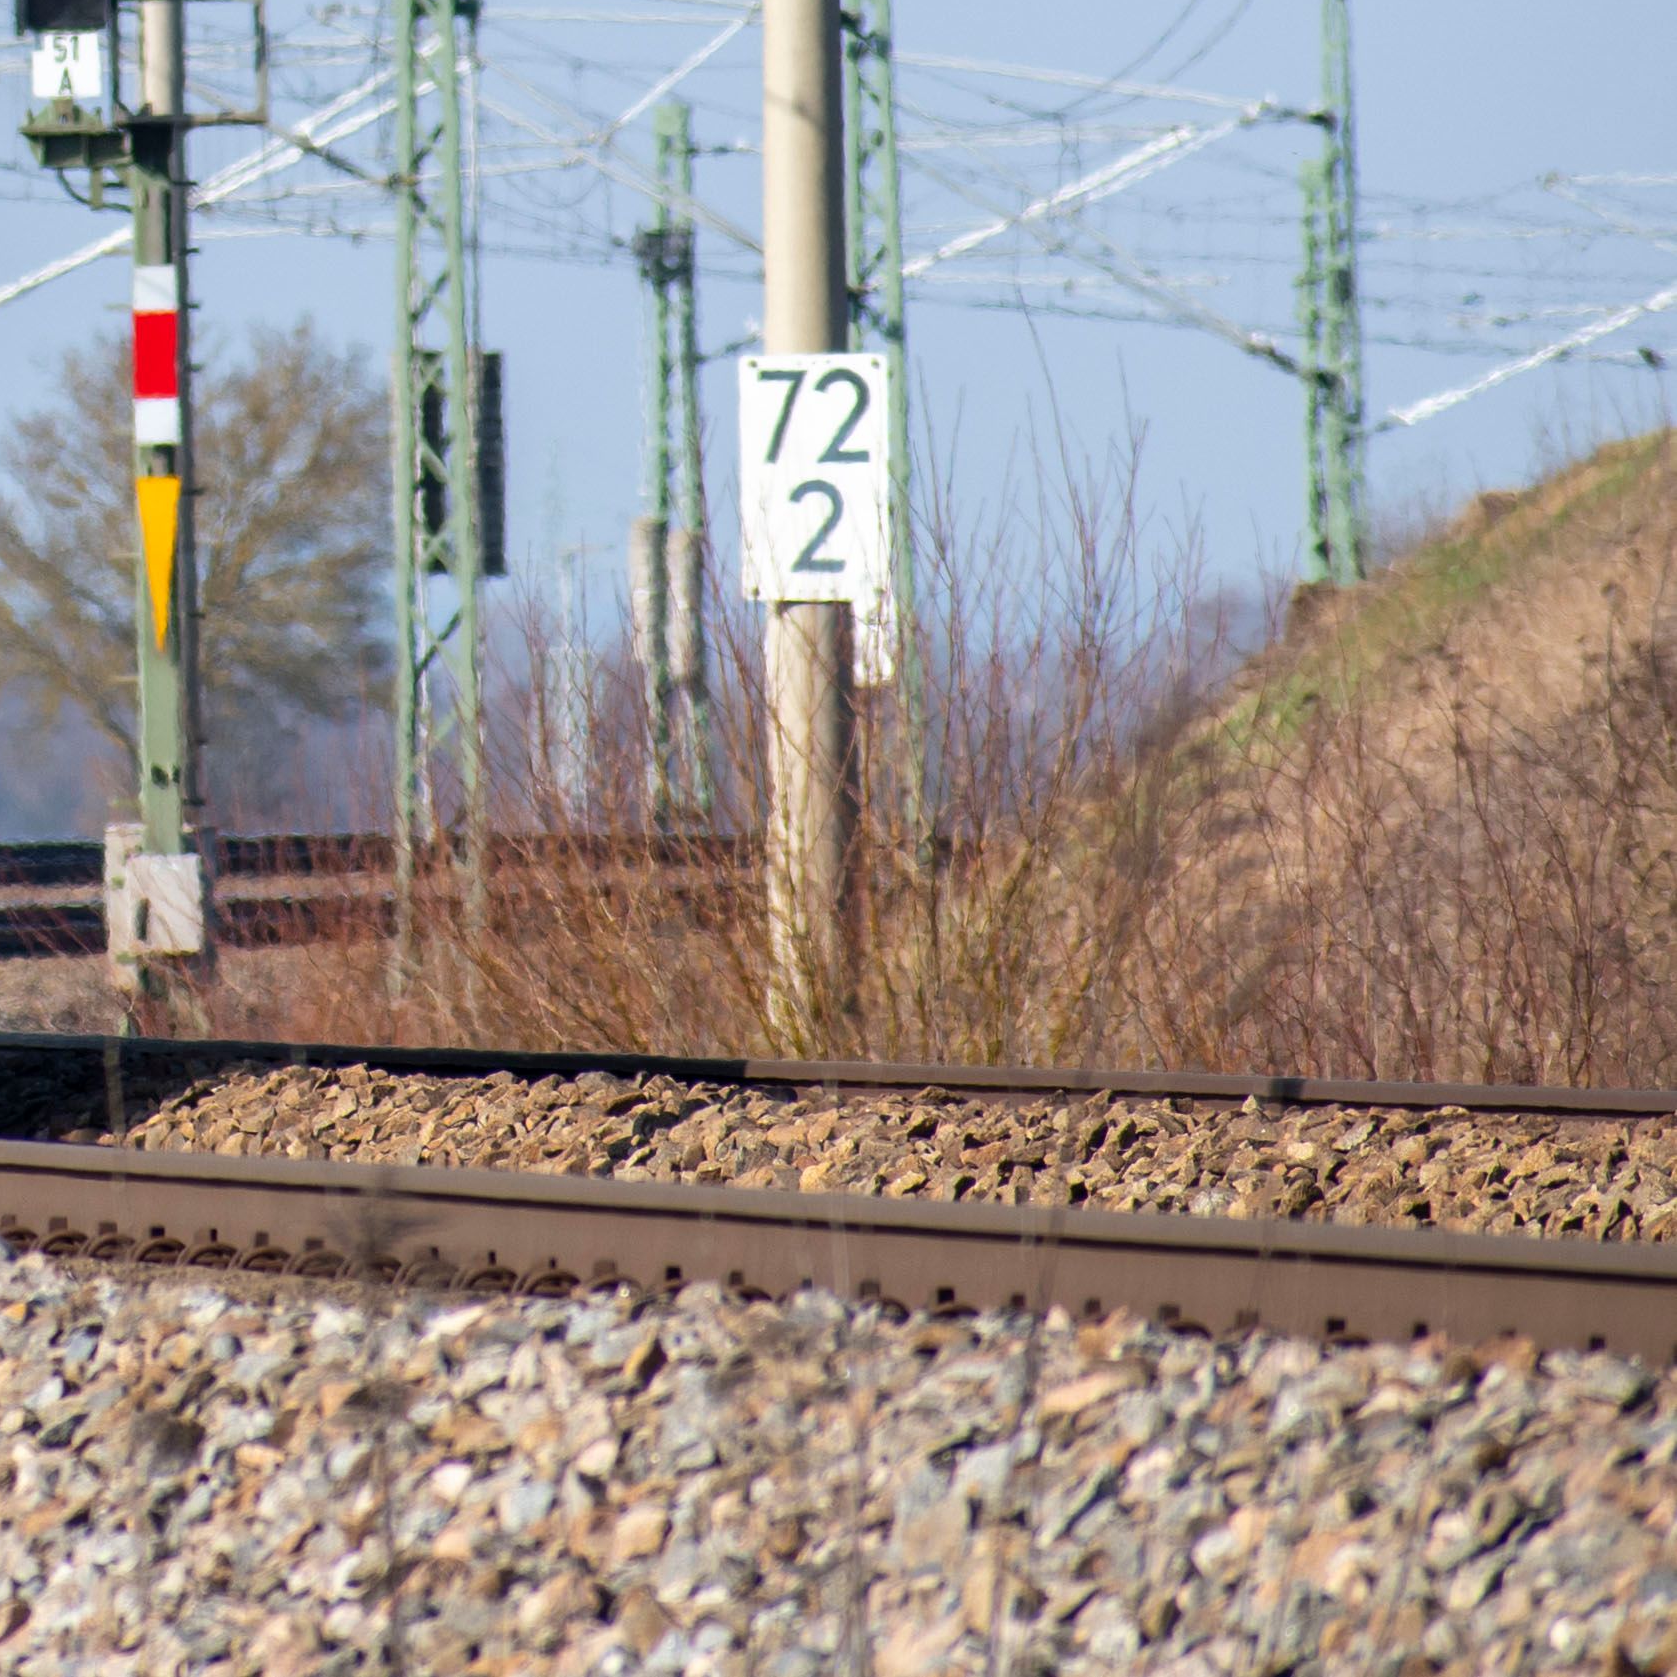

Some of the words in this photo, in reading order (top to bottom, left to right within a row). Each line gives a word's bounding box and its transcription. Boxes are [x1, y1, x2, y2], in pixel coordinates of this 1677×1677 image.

[53, 35, 79, 63] 51
[58, 68, 73, 95] A
[758, 367, 871, 463] 72
[788, 479, 847, 573] 2
